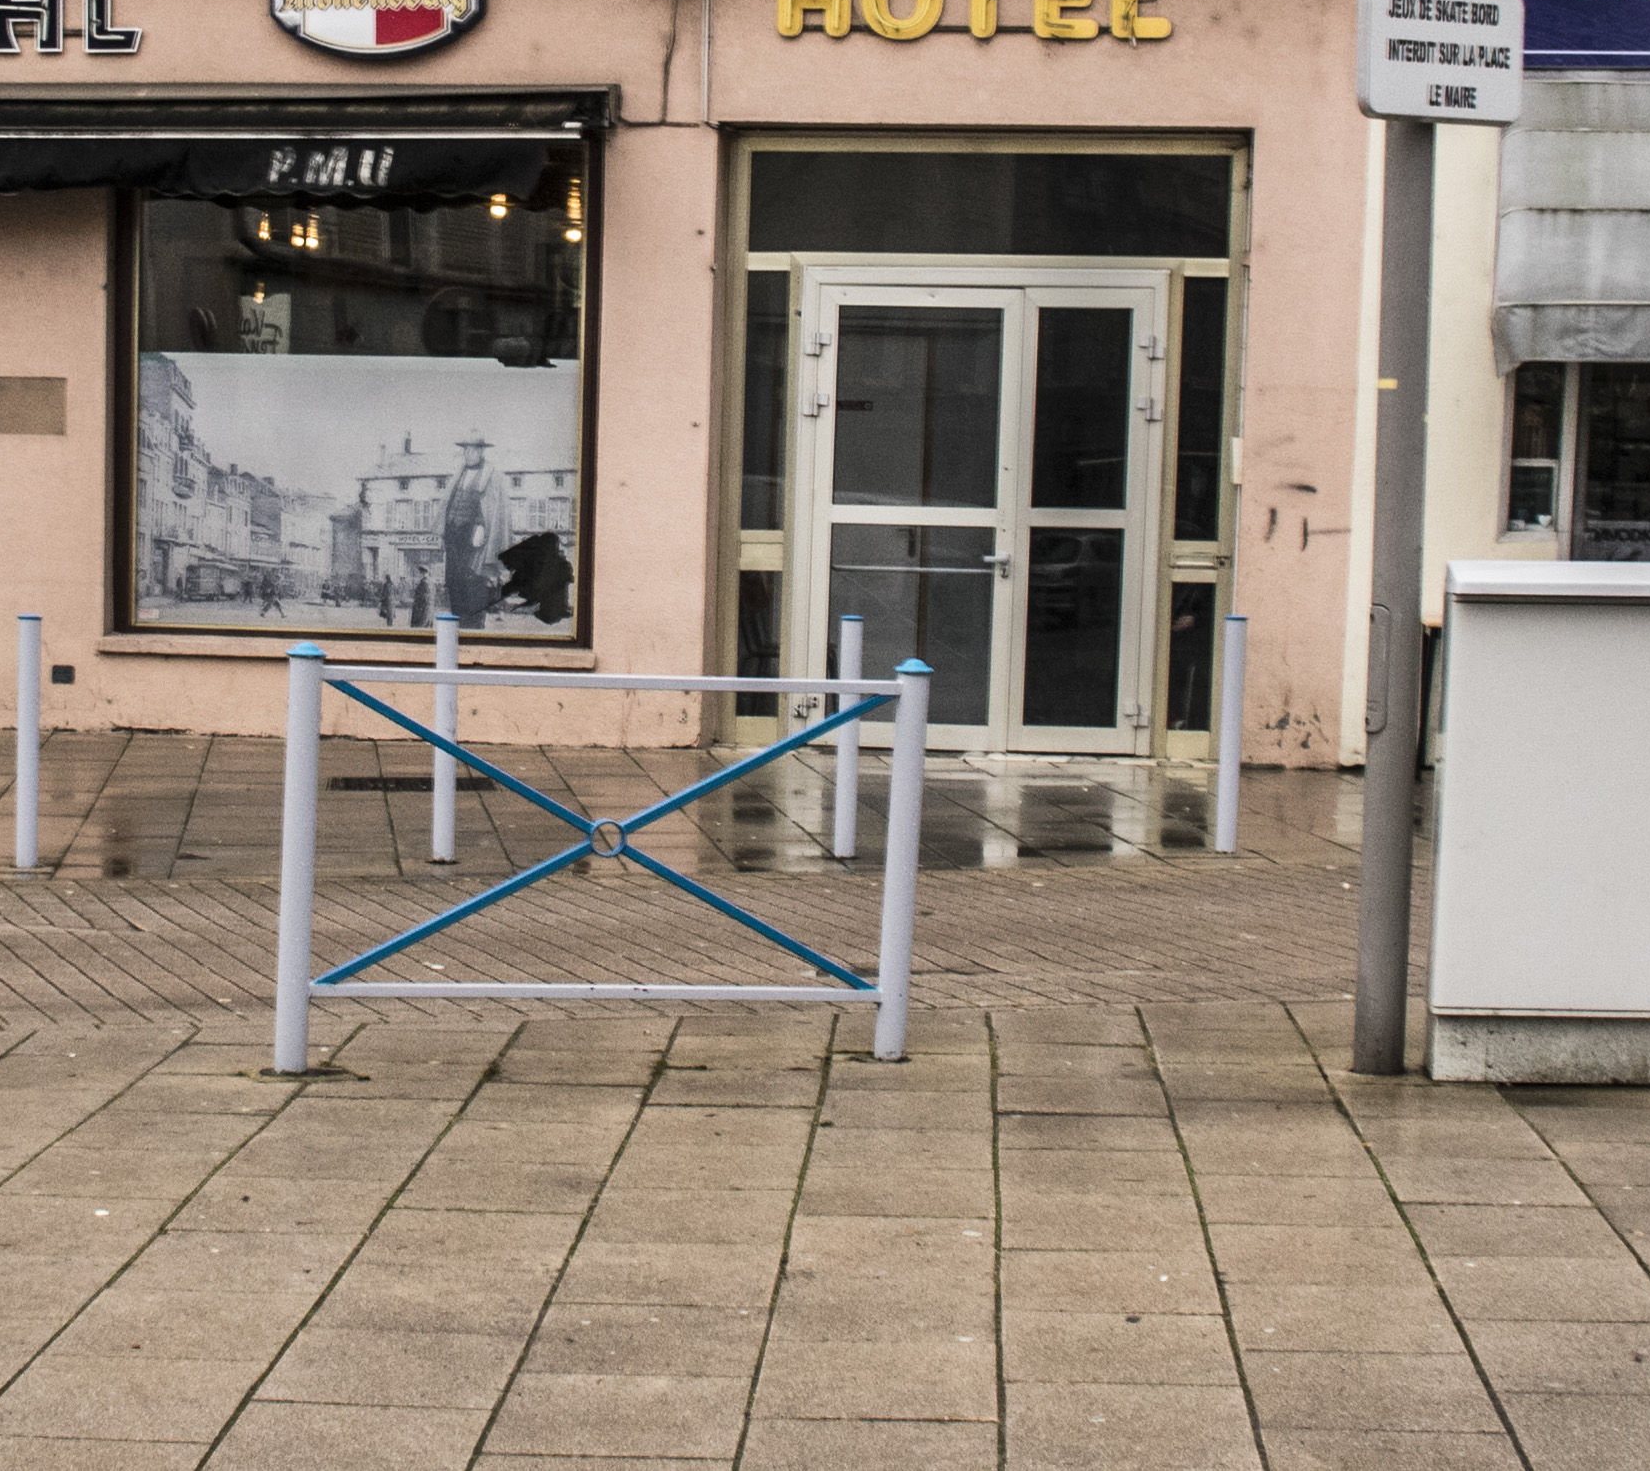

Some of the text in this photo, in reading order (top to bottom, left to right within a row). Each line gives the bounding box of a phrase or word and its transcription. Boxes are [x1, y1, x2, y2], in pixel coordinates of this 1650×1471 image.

[1435, 0, 1470, 24] SKATE
[1471, 2, 1501, 26] BORD
[1387, 38, 1511, 69] INTERDIT SUR LA PLACE
[1429, 84, 1477, 109] LE MAIRE
